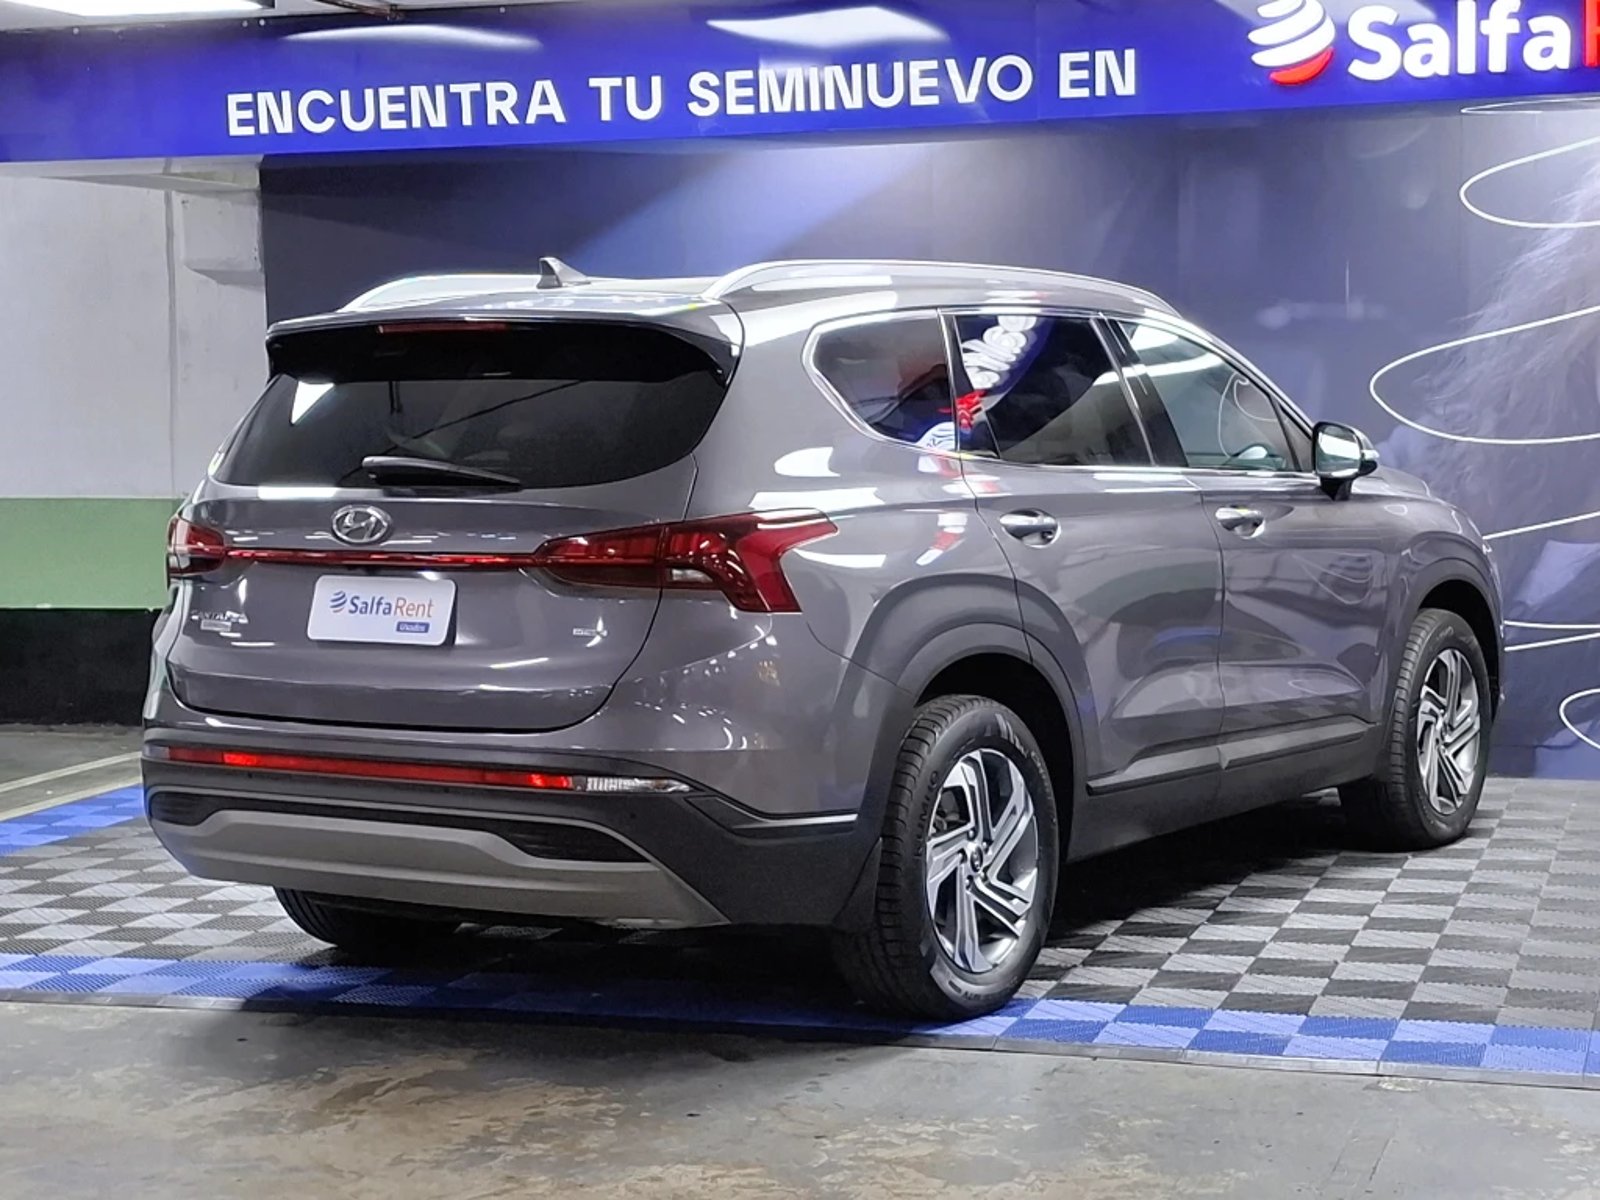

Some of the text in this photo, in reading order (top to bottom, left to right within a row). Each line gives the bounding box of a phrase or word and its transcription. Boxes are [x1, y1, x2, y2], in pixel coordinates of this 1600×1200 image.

[226, 48, 1137, 136] ENCUENTRA TU SEMINUEVO EN
